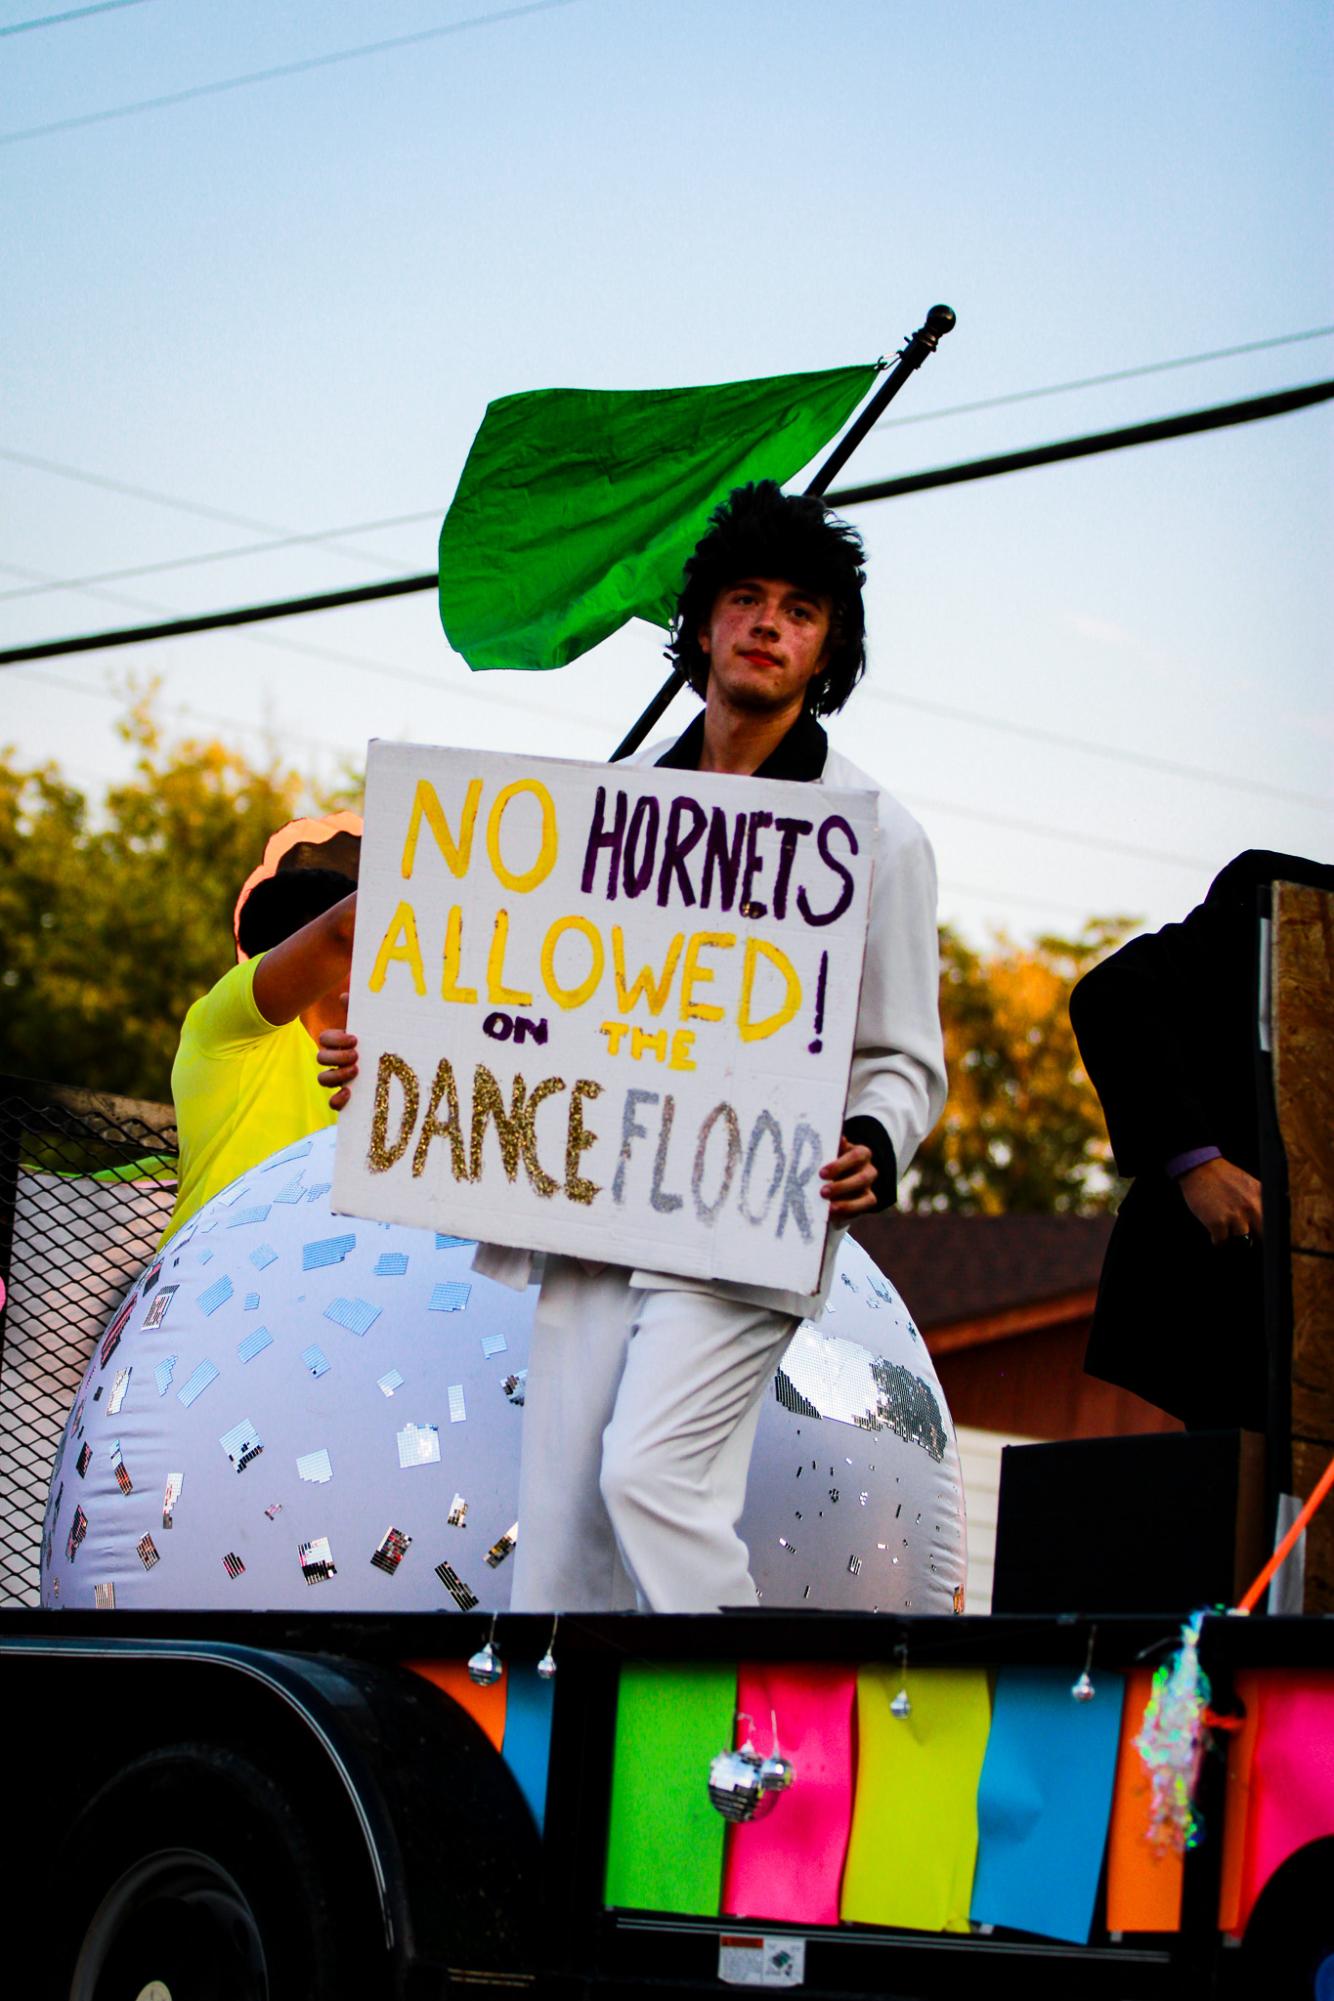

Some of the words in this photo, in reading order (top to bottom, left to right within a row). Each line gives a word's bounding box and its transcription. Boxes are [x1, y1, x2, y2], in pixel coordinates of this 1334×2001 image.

[401, 778, 558, 893] NO
[580, 786, 859, 927] HORNETS
[368, 901, 829, 1055] ALLOWED!
[482, 1011, 548, 1045] ON
[600, 1021, 697, 1071] THE
[367, 1052, 605, 1206] DANCE
[611, 1087, 824, 1244] FLOOR
